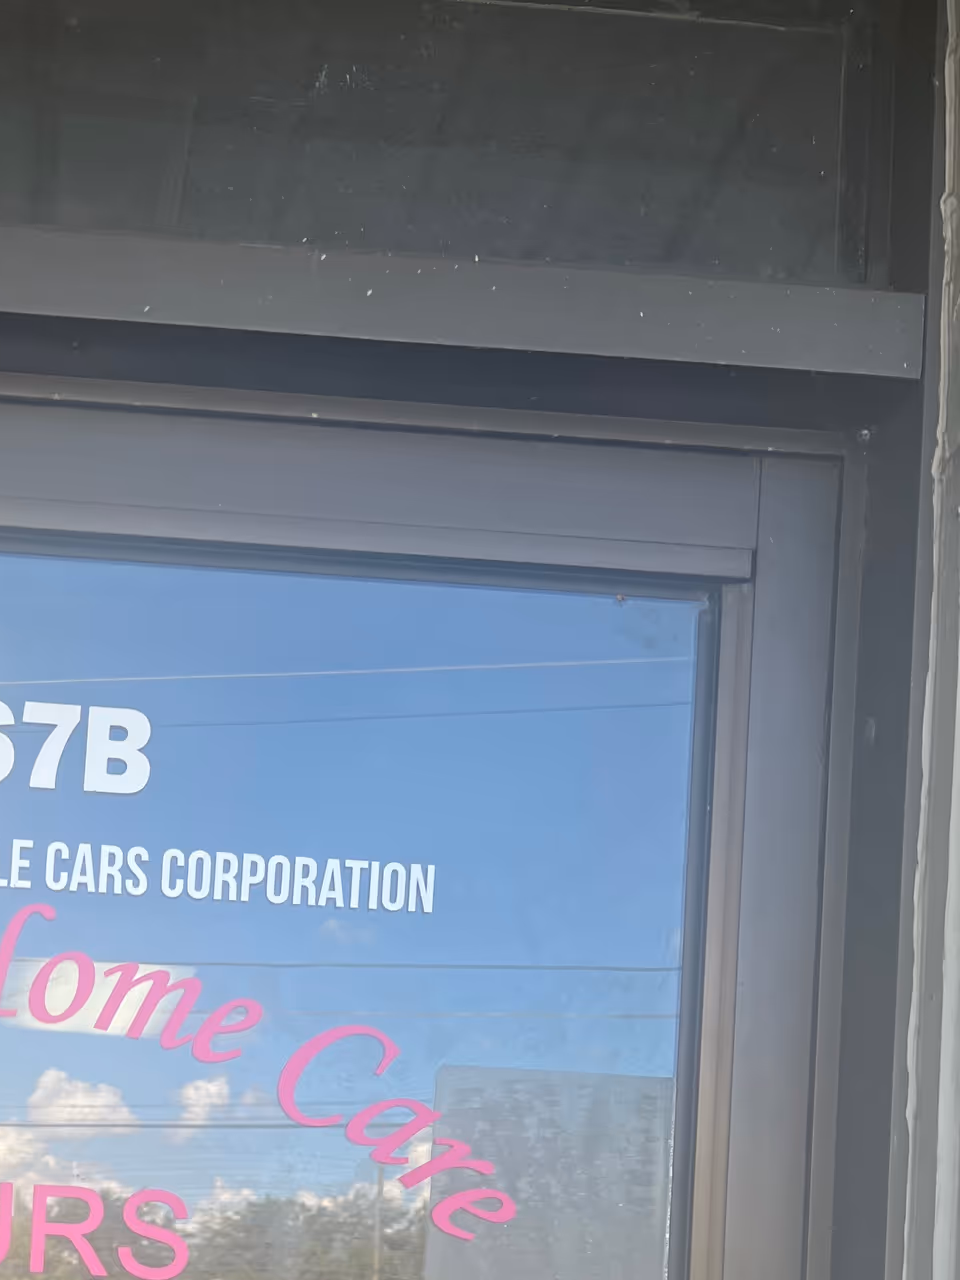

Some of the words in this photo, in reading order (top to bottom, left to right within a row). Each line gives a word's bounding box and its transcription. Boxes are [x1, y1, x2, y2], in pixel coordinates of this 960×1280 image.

[44, 840, 149, 898] CARS
[160, 848, 436, 914] CORPORATION
[278, 1024, 517, 1241] Care
